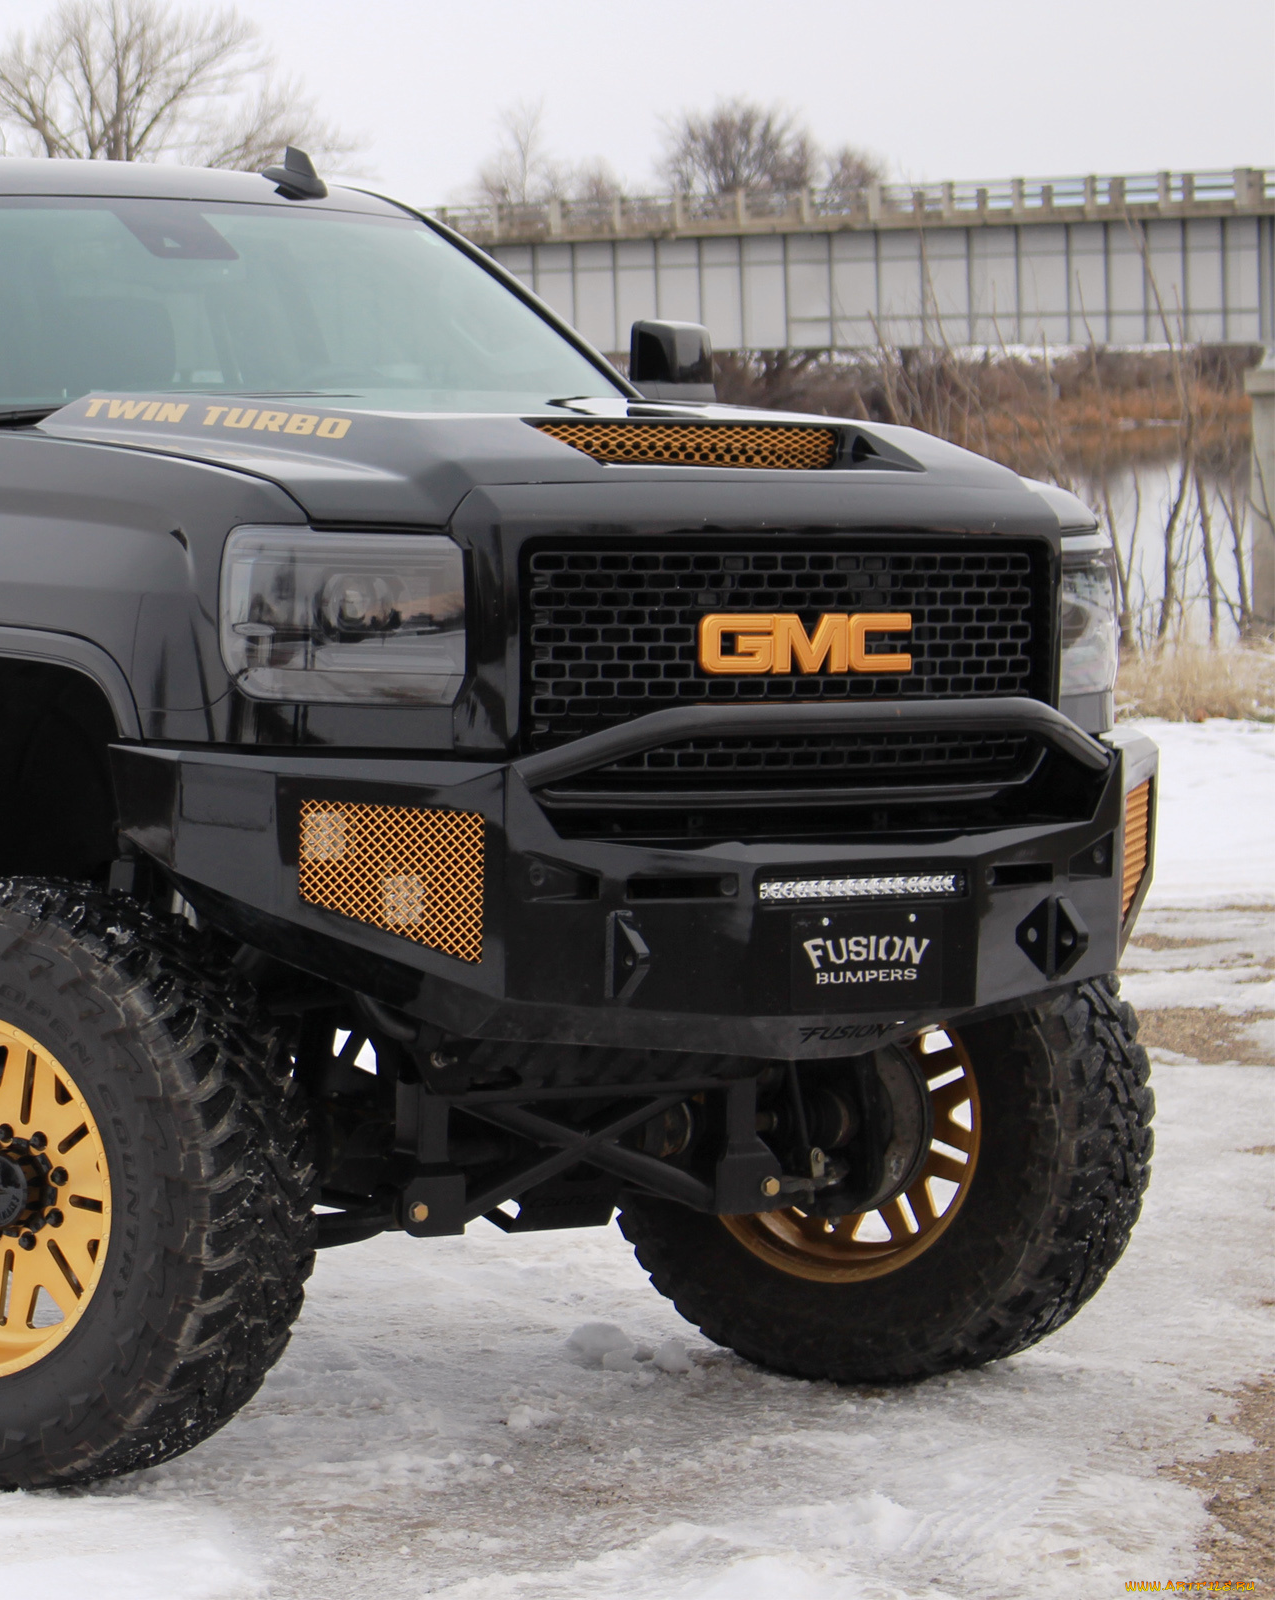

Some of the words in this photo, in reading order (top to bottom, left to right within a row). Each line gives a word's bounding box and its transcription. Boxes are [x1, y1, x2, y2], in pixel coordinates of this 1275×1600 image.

[85, 399, 190, 423] TWIN
[203, 406, 353, 439] TURBO
[699, 613, 912, 674] GMC
[803, 935, 930, 969] FUSION
[816, 968, 918, 985] BUMPERS
[798, 1022, 897, 1044] FUSION
